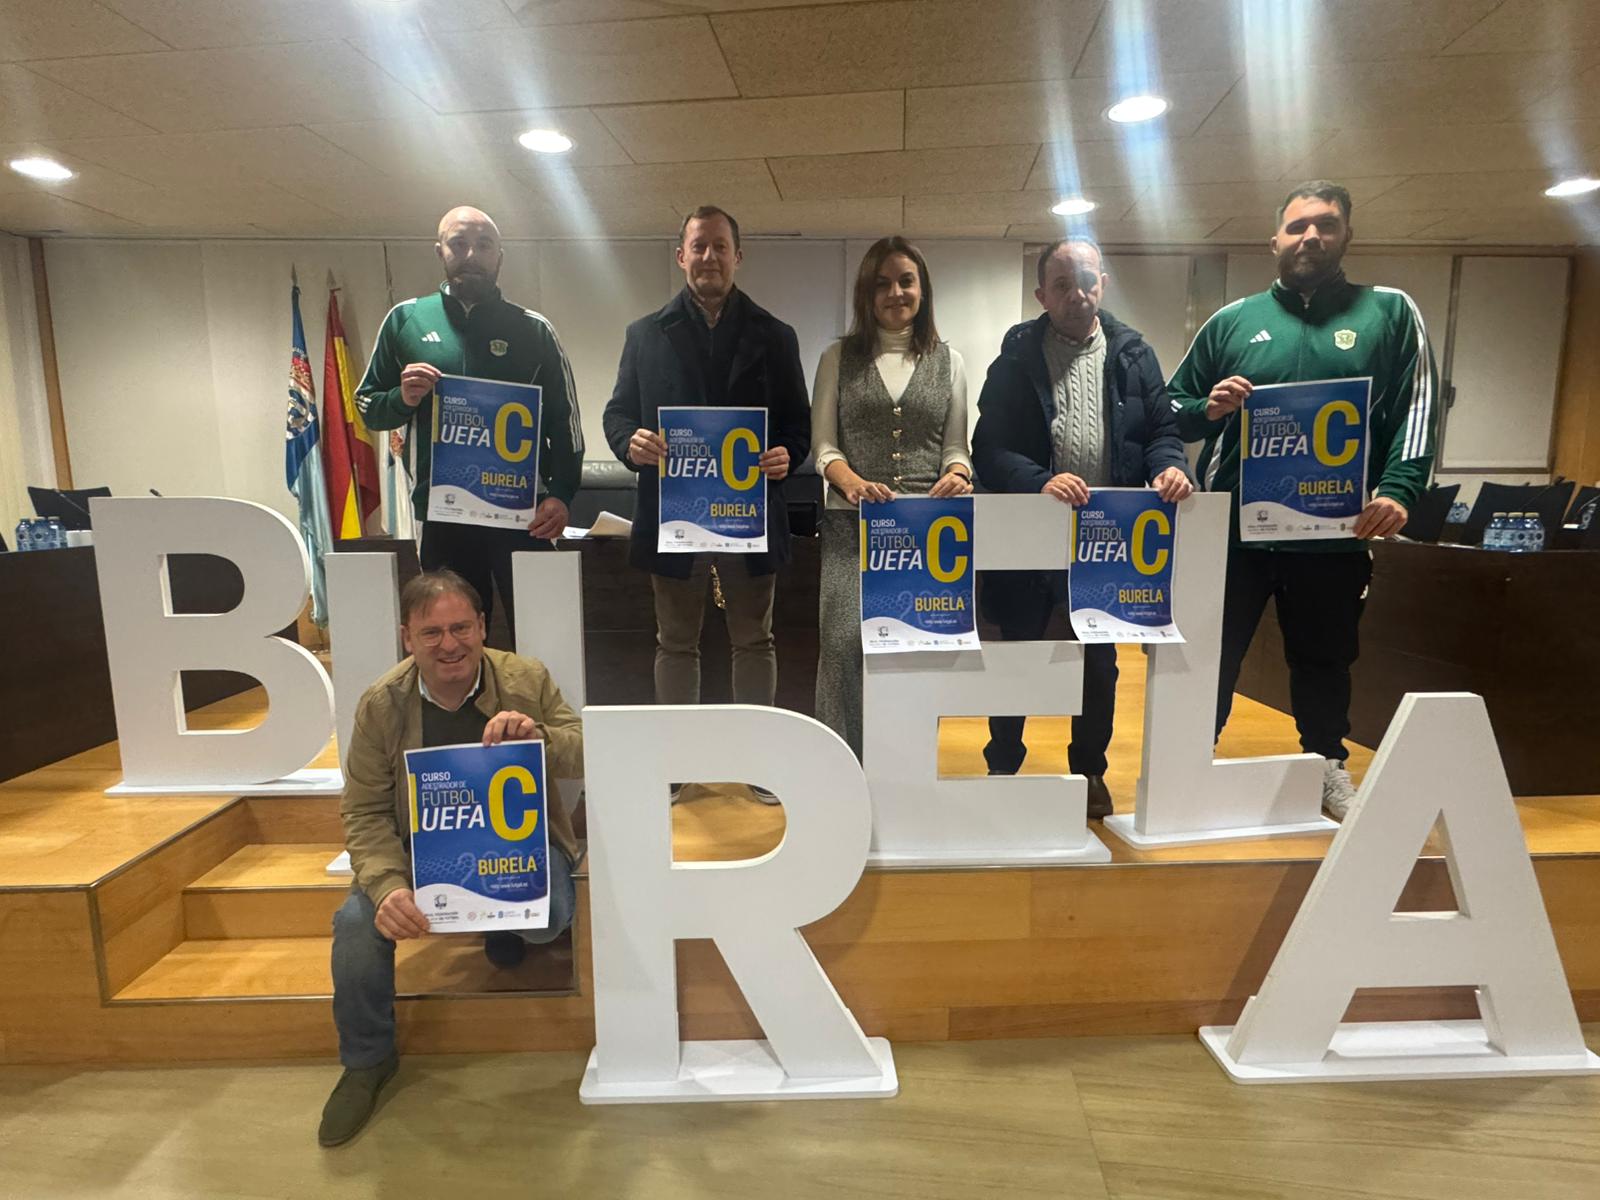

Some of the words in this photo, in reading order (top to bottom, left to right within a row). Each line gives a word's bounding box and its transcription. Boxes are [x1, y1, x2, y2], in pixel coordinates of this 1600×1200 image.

[443, 396, 467, 406] CURSO
[1253, 407, 1280, 417] CURSO
[440, 424, 490, 448] UEFA
[494, 402, 534, 463] C
[669, 428, 693, 437] CURSO
[1312, 400, 1360, 467] C
[1251, 435, 1308, 458] UEFA
[668, 458, 718, 478] UEFA
[721, 427, 760, 491] C
[481, 472, 527, 488] BURELA
[1298, 480, 1354, 495] BURELA
[710, 503, 757, 517] BURELA
[1081, 510, 1104, 519] CURSO
[871, 518, 896, 528] CURSO
[926, 515, 968, 583] C
[1078, 541, 1127, 562] UEFA
[1131, 509, 1170, 576] C
[869, 549, 923, 571] UEFA
[915, 597, 965, 612] BURELA
[1118, 589, 1163, 604] BURELA
[421, 771, 451, 782] CURSO
[488, 765, 539, 841] C
[422, 804, 485, 832] UEFA
[478, 856, 537, 876] BURELA
